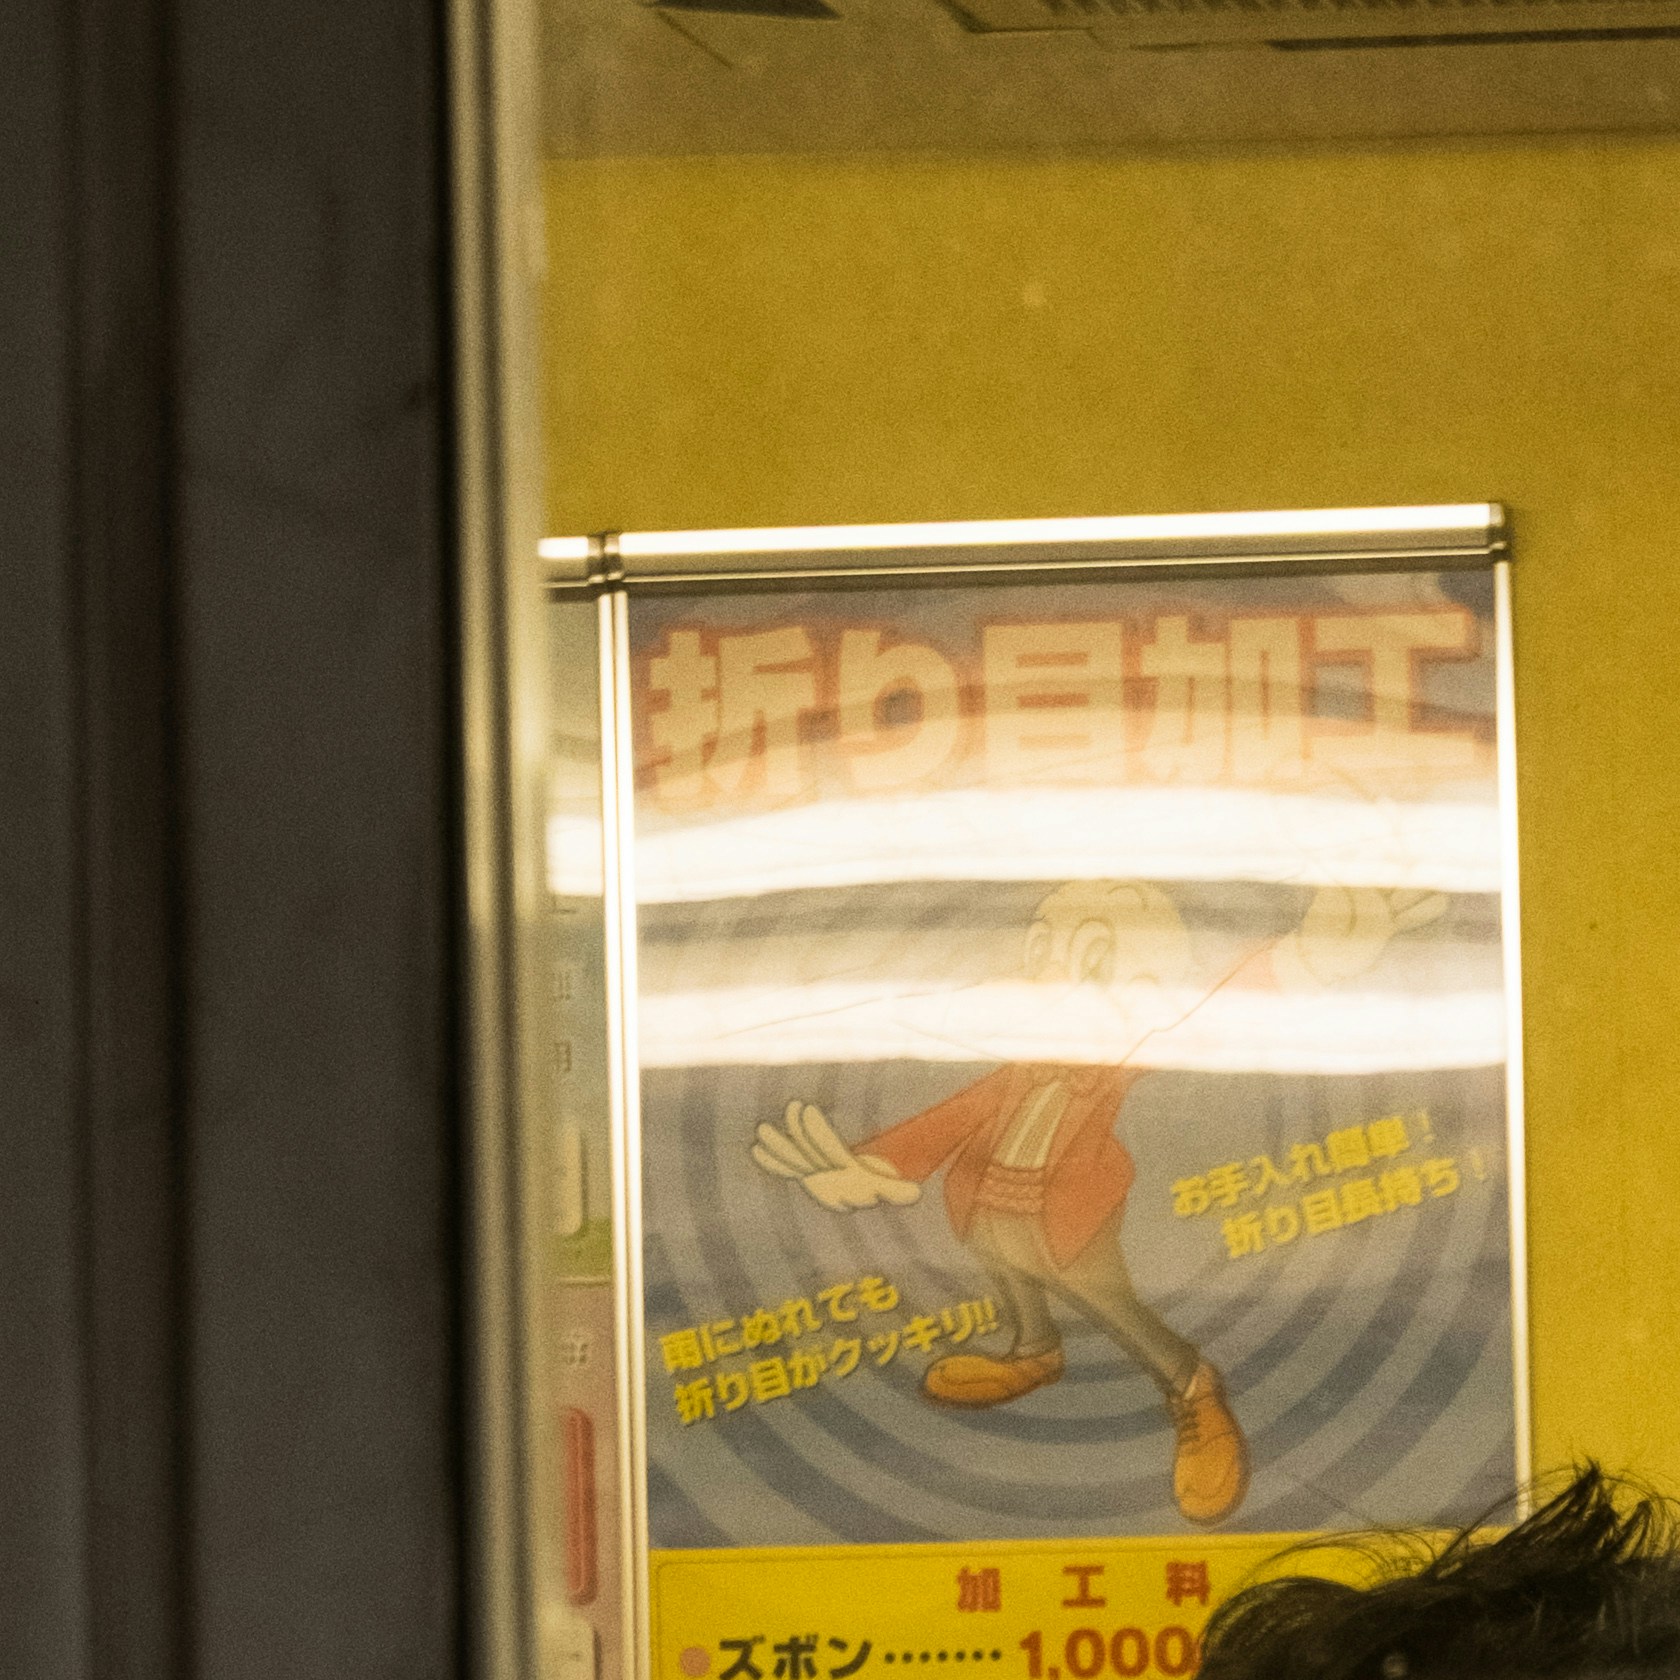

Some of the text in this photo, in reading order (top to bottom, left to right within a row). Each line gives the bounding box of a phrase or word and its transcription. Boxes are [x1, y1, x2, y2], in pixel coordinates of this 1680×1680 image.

[640, 608, 1480, 806] 折り目加工
[658, 1276, 900, 1374] 雨にぬれても
